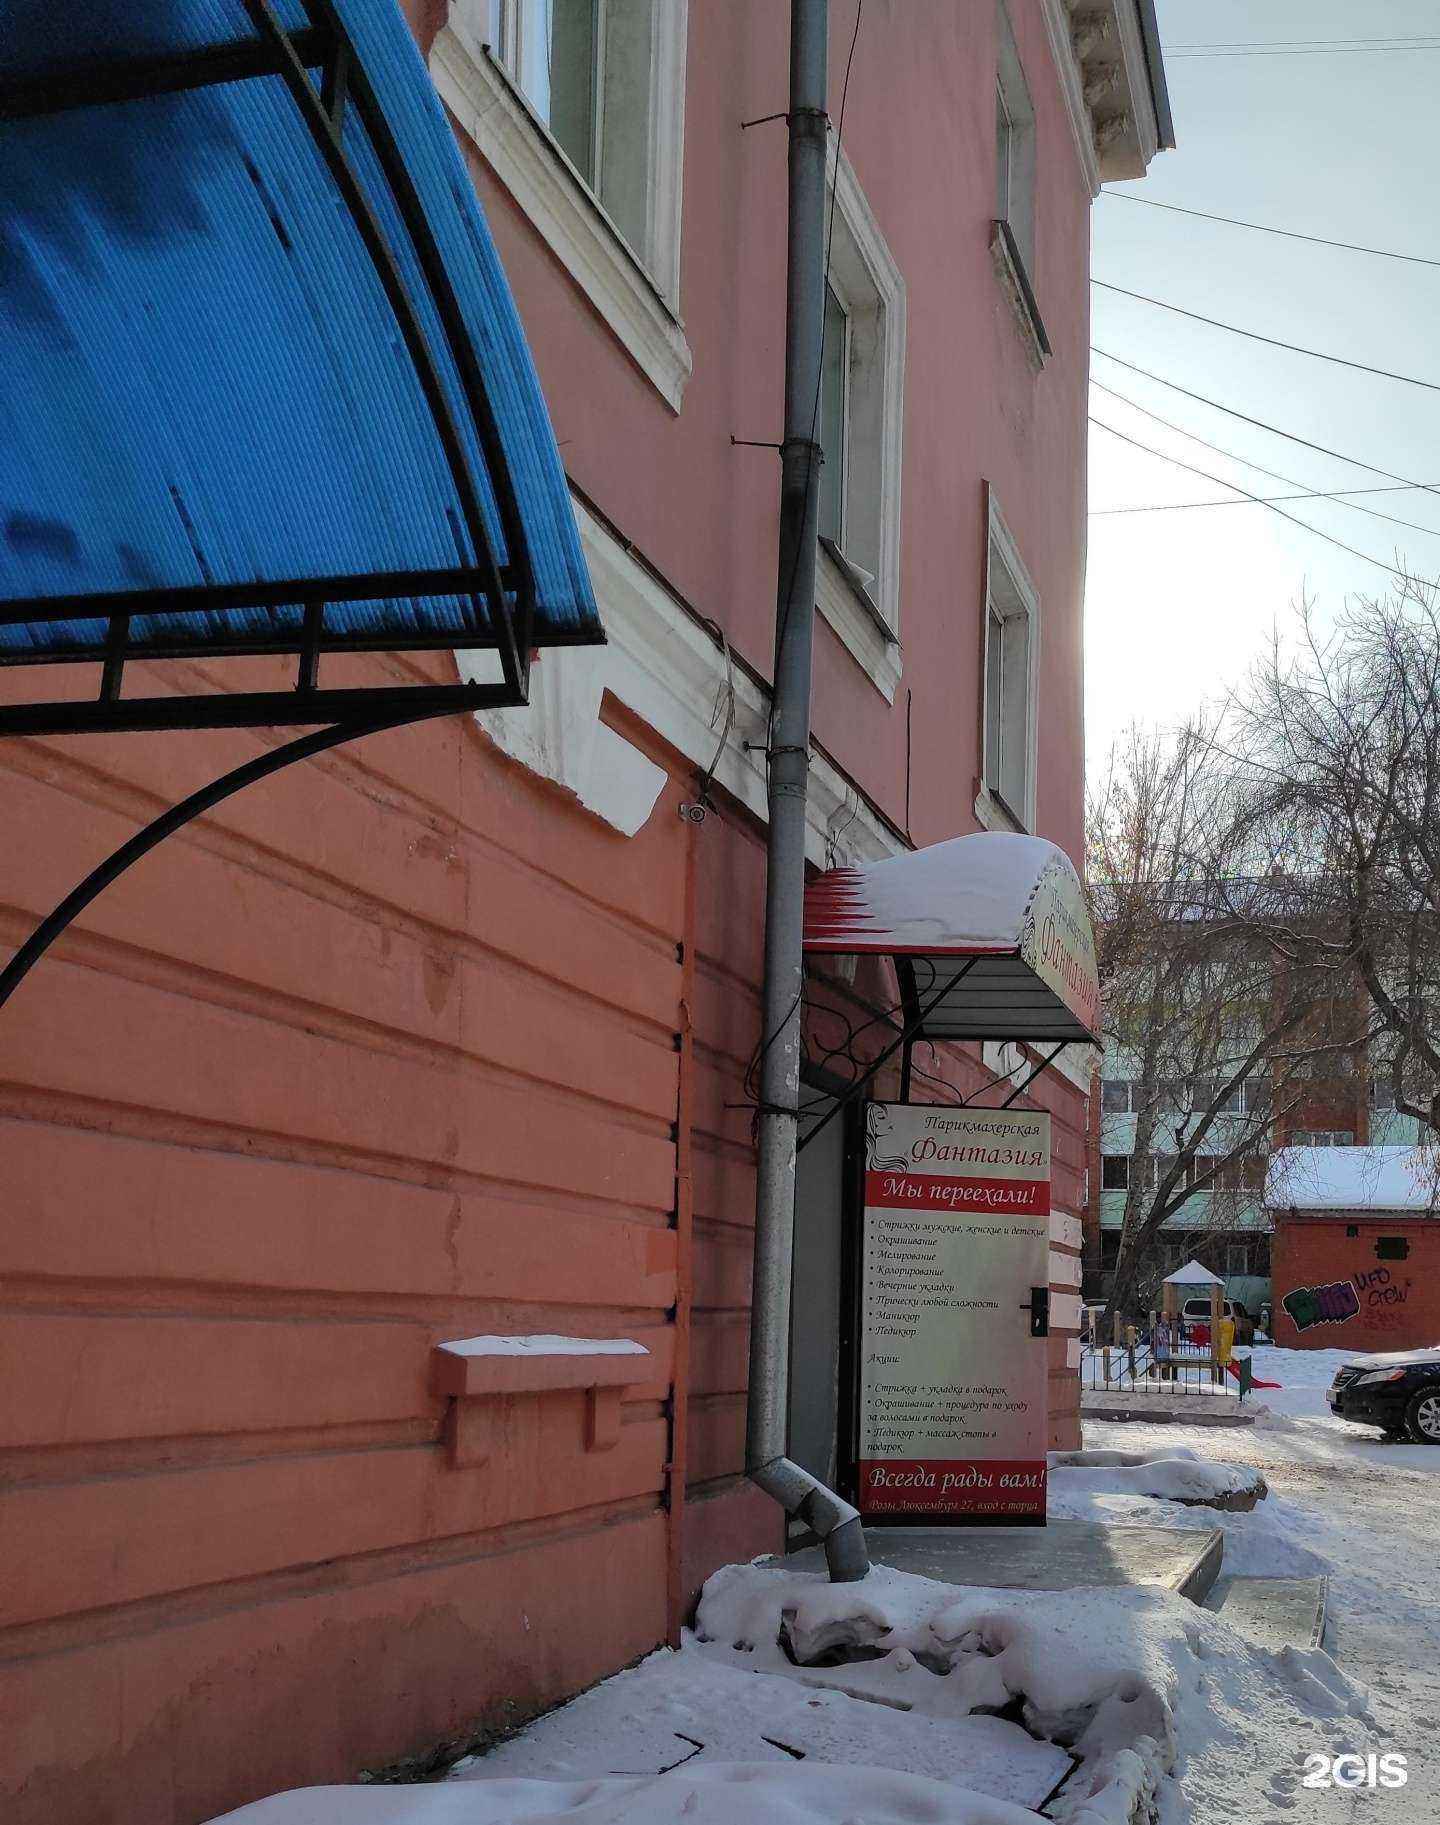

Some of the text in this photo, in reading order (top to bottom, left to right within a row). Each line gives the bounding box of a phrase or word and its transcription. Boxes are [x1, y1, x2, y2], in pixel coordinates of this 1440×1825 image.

[924, 1115, 1040, 1138] Парикмахерская
[882, 1178, 1036, 1206] Мы переехали!
[878, 1219, 1045, 1238] Стрижки мужские, женские и детские
[877, 1234, 938, 1247] Окрашивание
[877, 1250, 937, 1263] Мелирование
[876, 1265, 944, 1277] Колорирование
[876, 1280, 955, 1293] Вечерние укладки
[876, 1296, 1000, 1310] Прически любой сложности
[876, 1311, 920, 1323] Маникюр
[875, 1326, 917, 1338] Педикюр
[874, 1383, 918, 1396] Стрижка
[928, 1384, 963, 1397] укладка
[972, 1384, 1008, 1397] подарок
[874, 1398, 935, 1411] Окрашивание
[945, 1401, 989, 1413] процедура
[1004, 1401, 1029, 1412] уходу
[867, 1414, 877, 1422] за
[880, 1414, 920, 1423] волосами
[930, 1414, 966, 1425] подарок
[873, 1427, 915, 1439] Педикюр
[925, 1430, 961, 1440] массаж
[961, 1431, 990, 1439] стопы
[867, 1442, 904, 1454] подарок
[869, 1465, 1045, 1494] Всегда рады вам!
[871, 1500, 896, 1511] Розы
[977, 1500, 998, 1510] вход
[1008, 1502, 1038, 1513] торца
